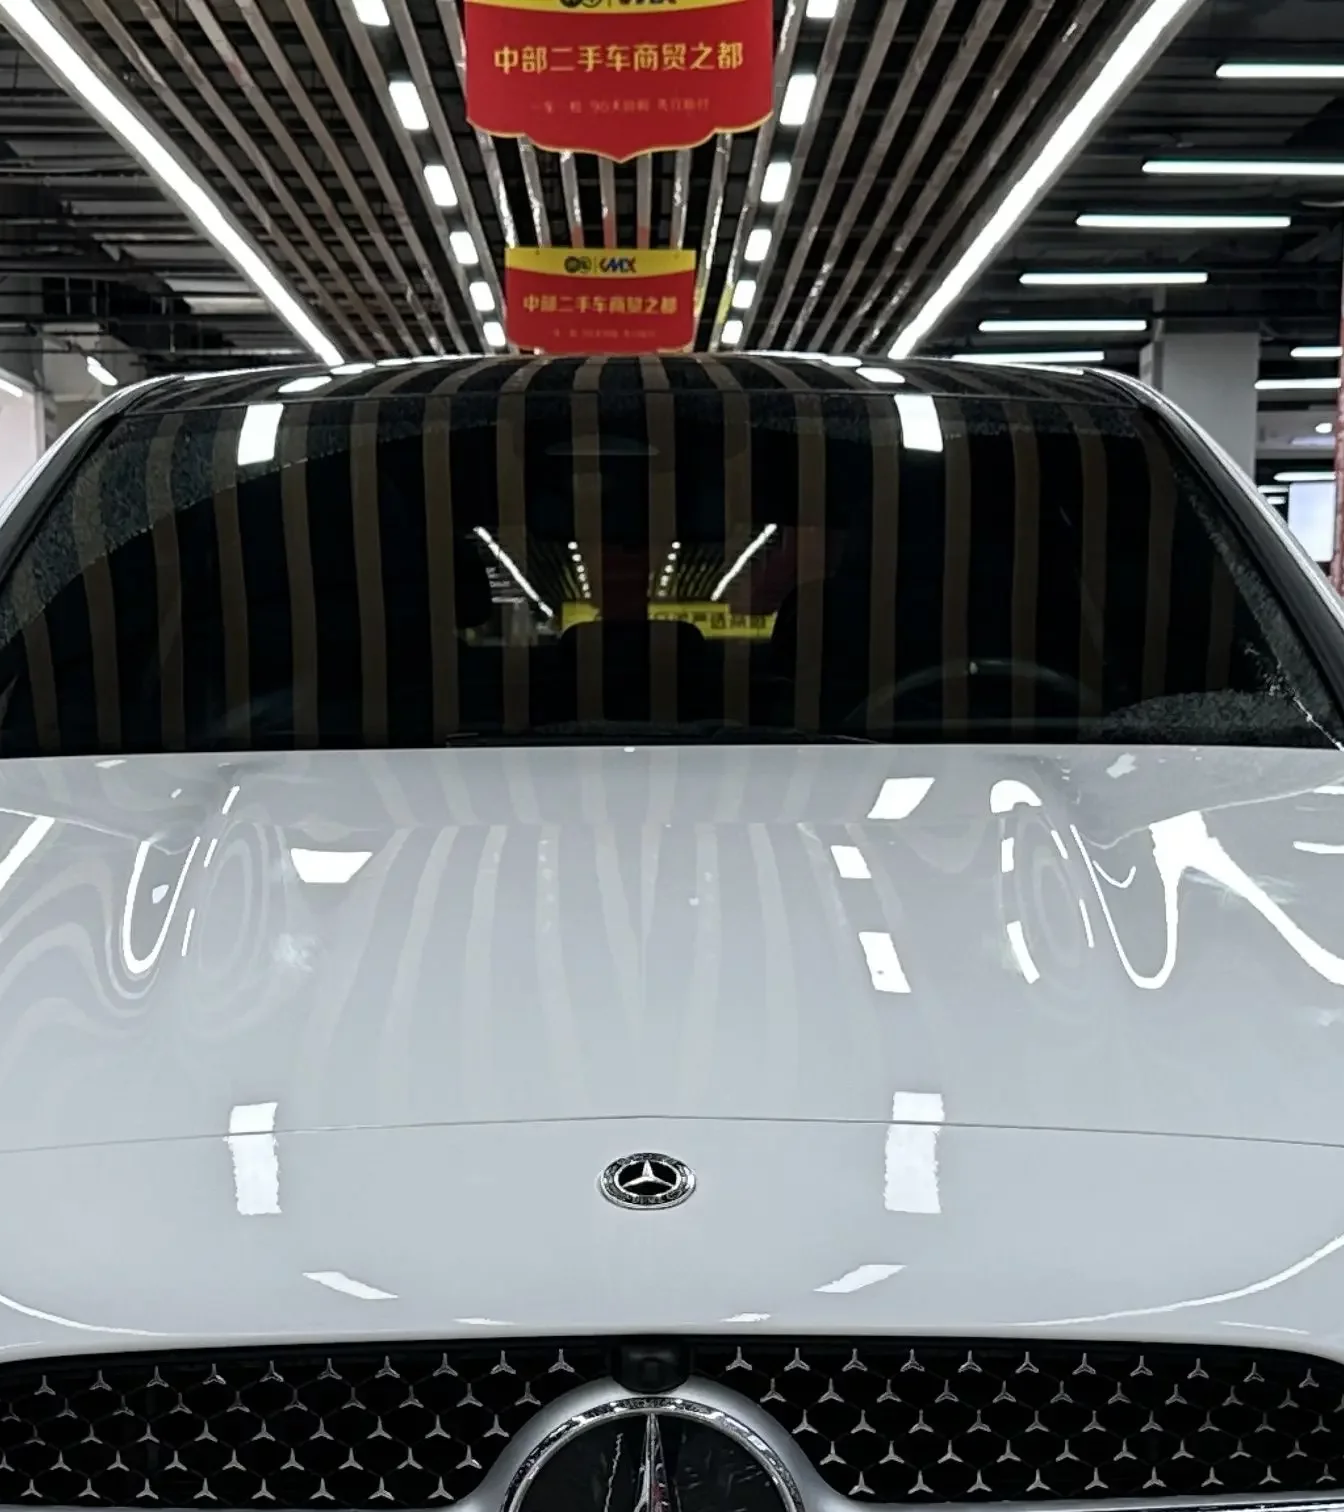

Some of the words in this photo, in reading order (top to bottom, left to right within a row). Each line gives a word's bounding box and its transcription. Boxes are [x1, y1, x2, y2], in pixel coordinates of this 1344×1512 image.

[494, 41, 744, 75] 中部二手车商贸之都
